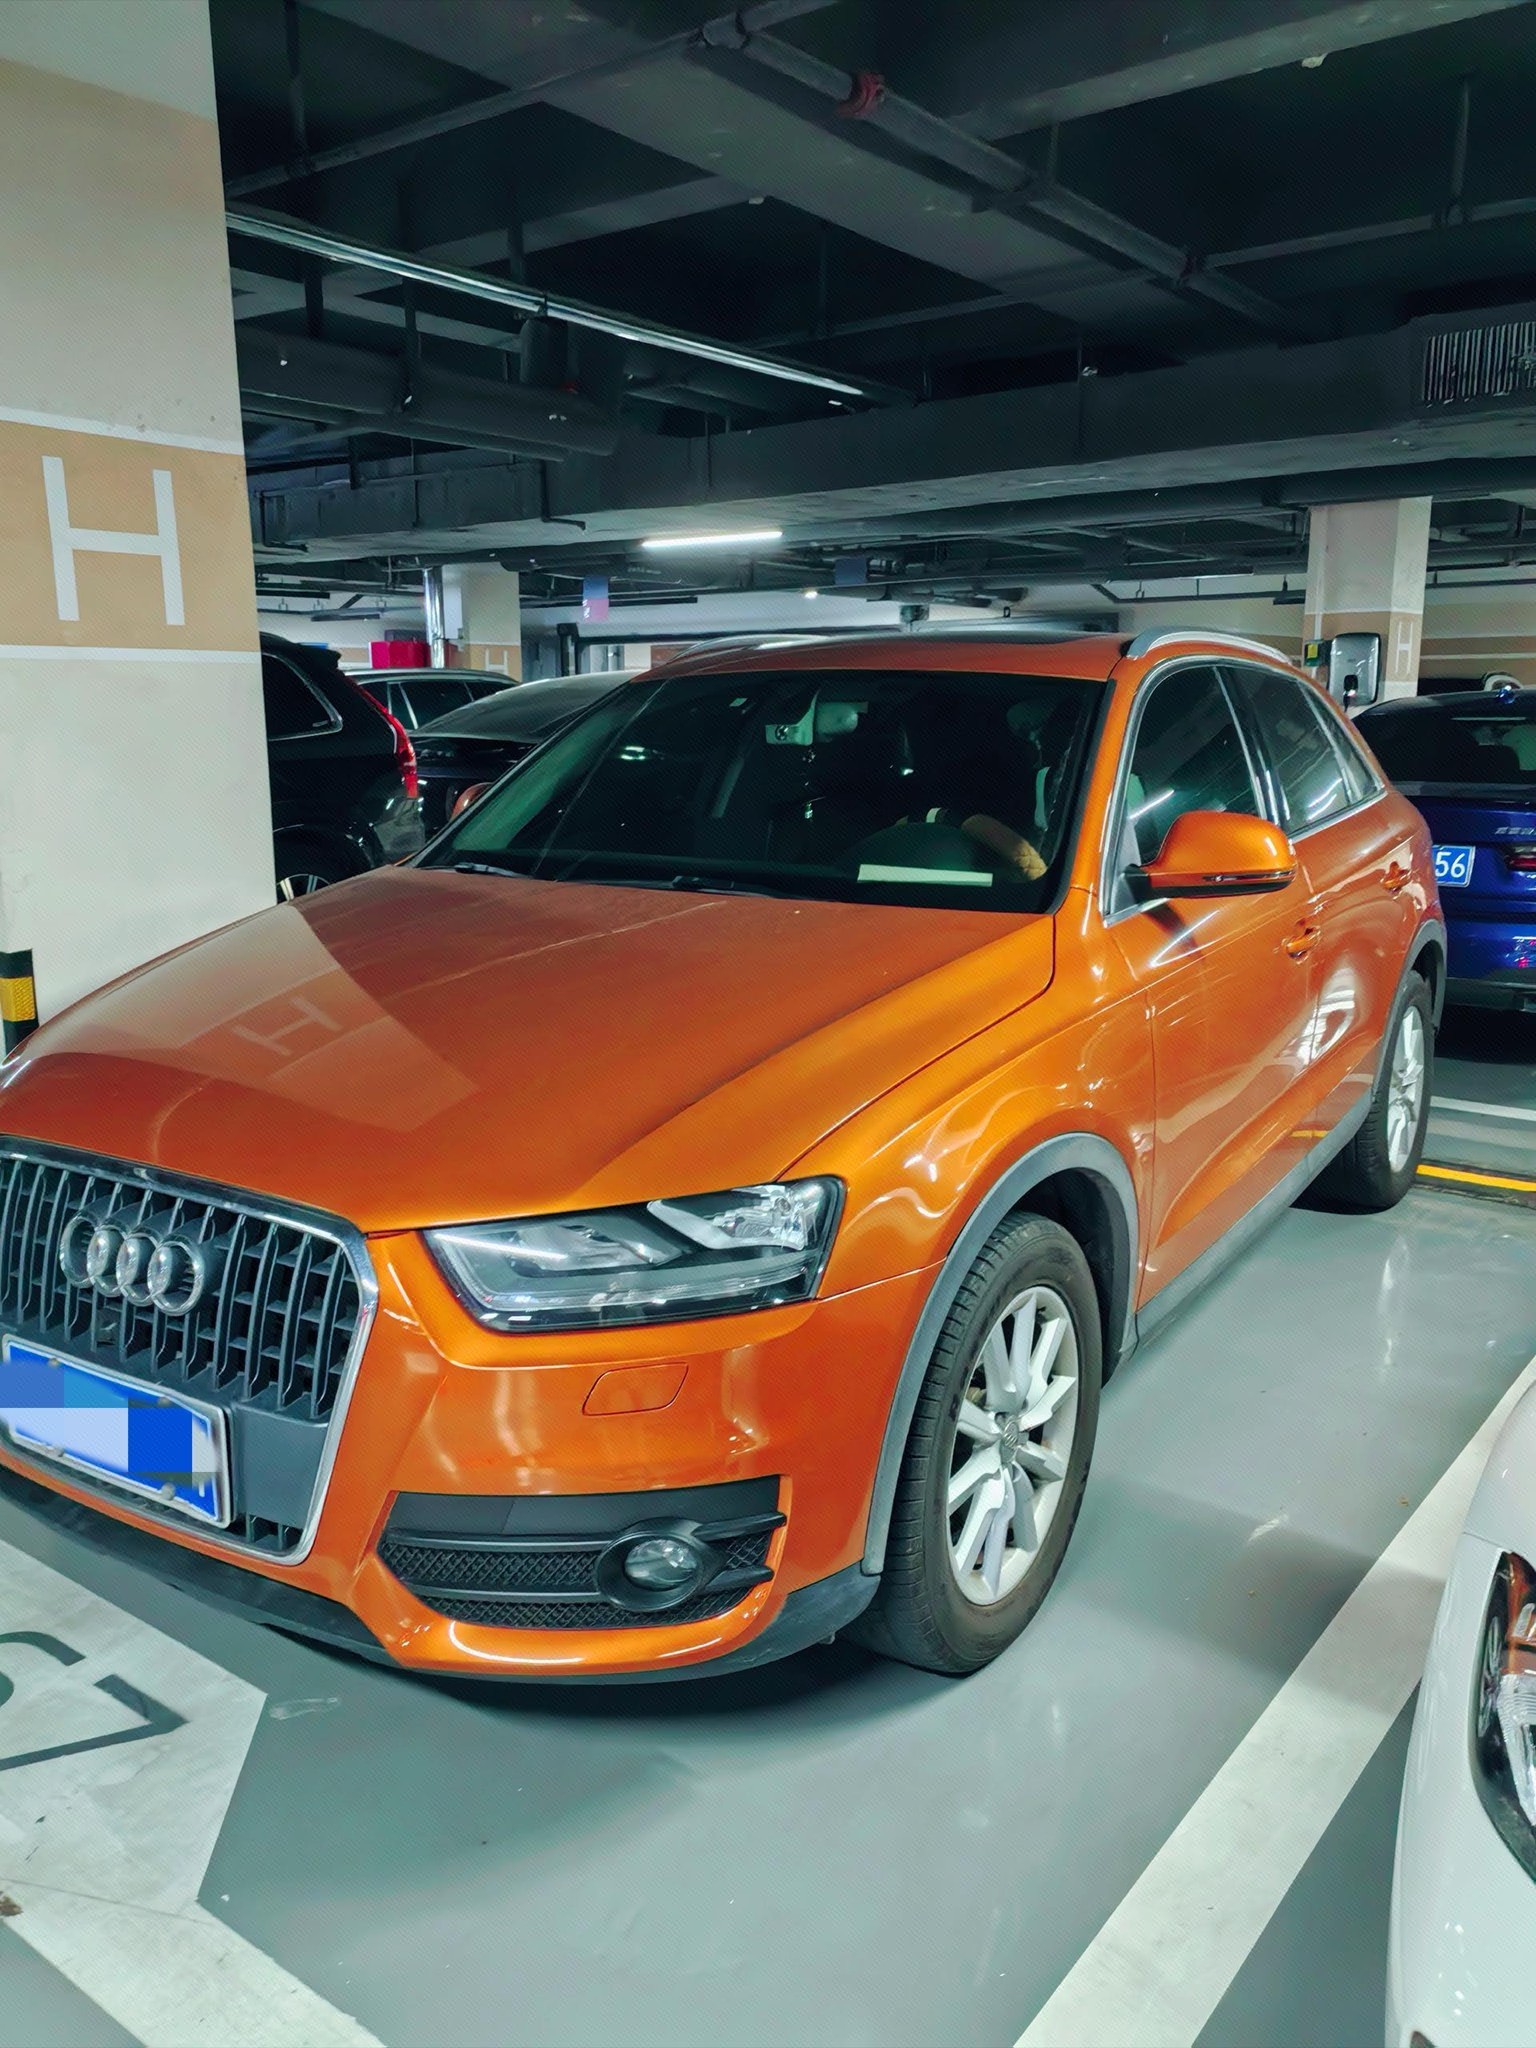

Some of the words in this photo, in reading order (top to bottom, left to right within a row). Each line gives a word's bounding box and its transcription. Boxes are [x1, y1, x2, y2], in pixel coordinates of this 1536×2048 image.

[42, 455, 185, 626] H
[1395, 620, 1414, 675] H
[1434, 851, 1466, 878] 56
